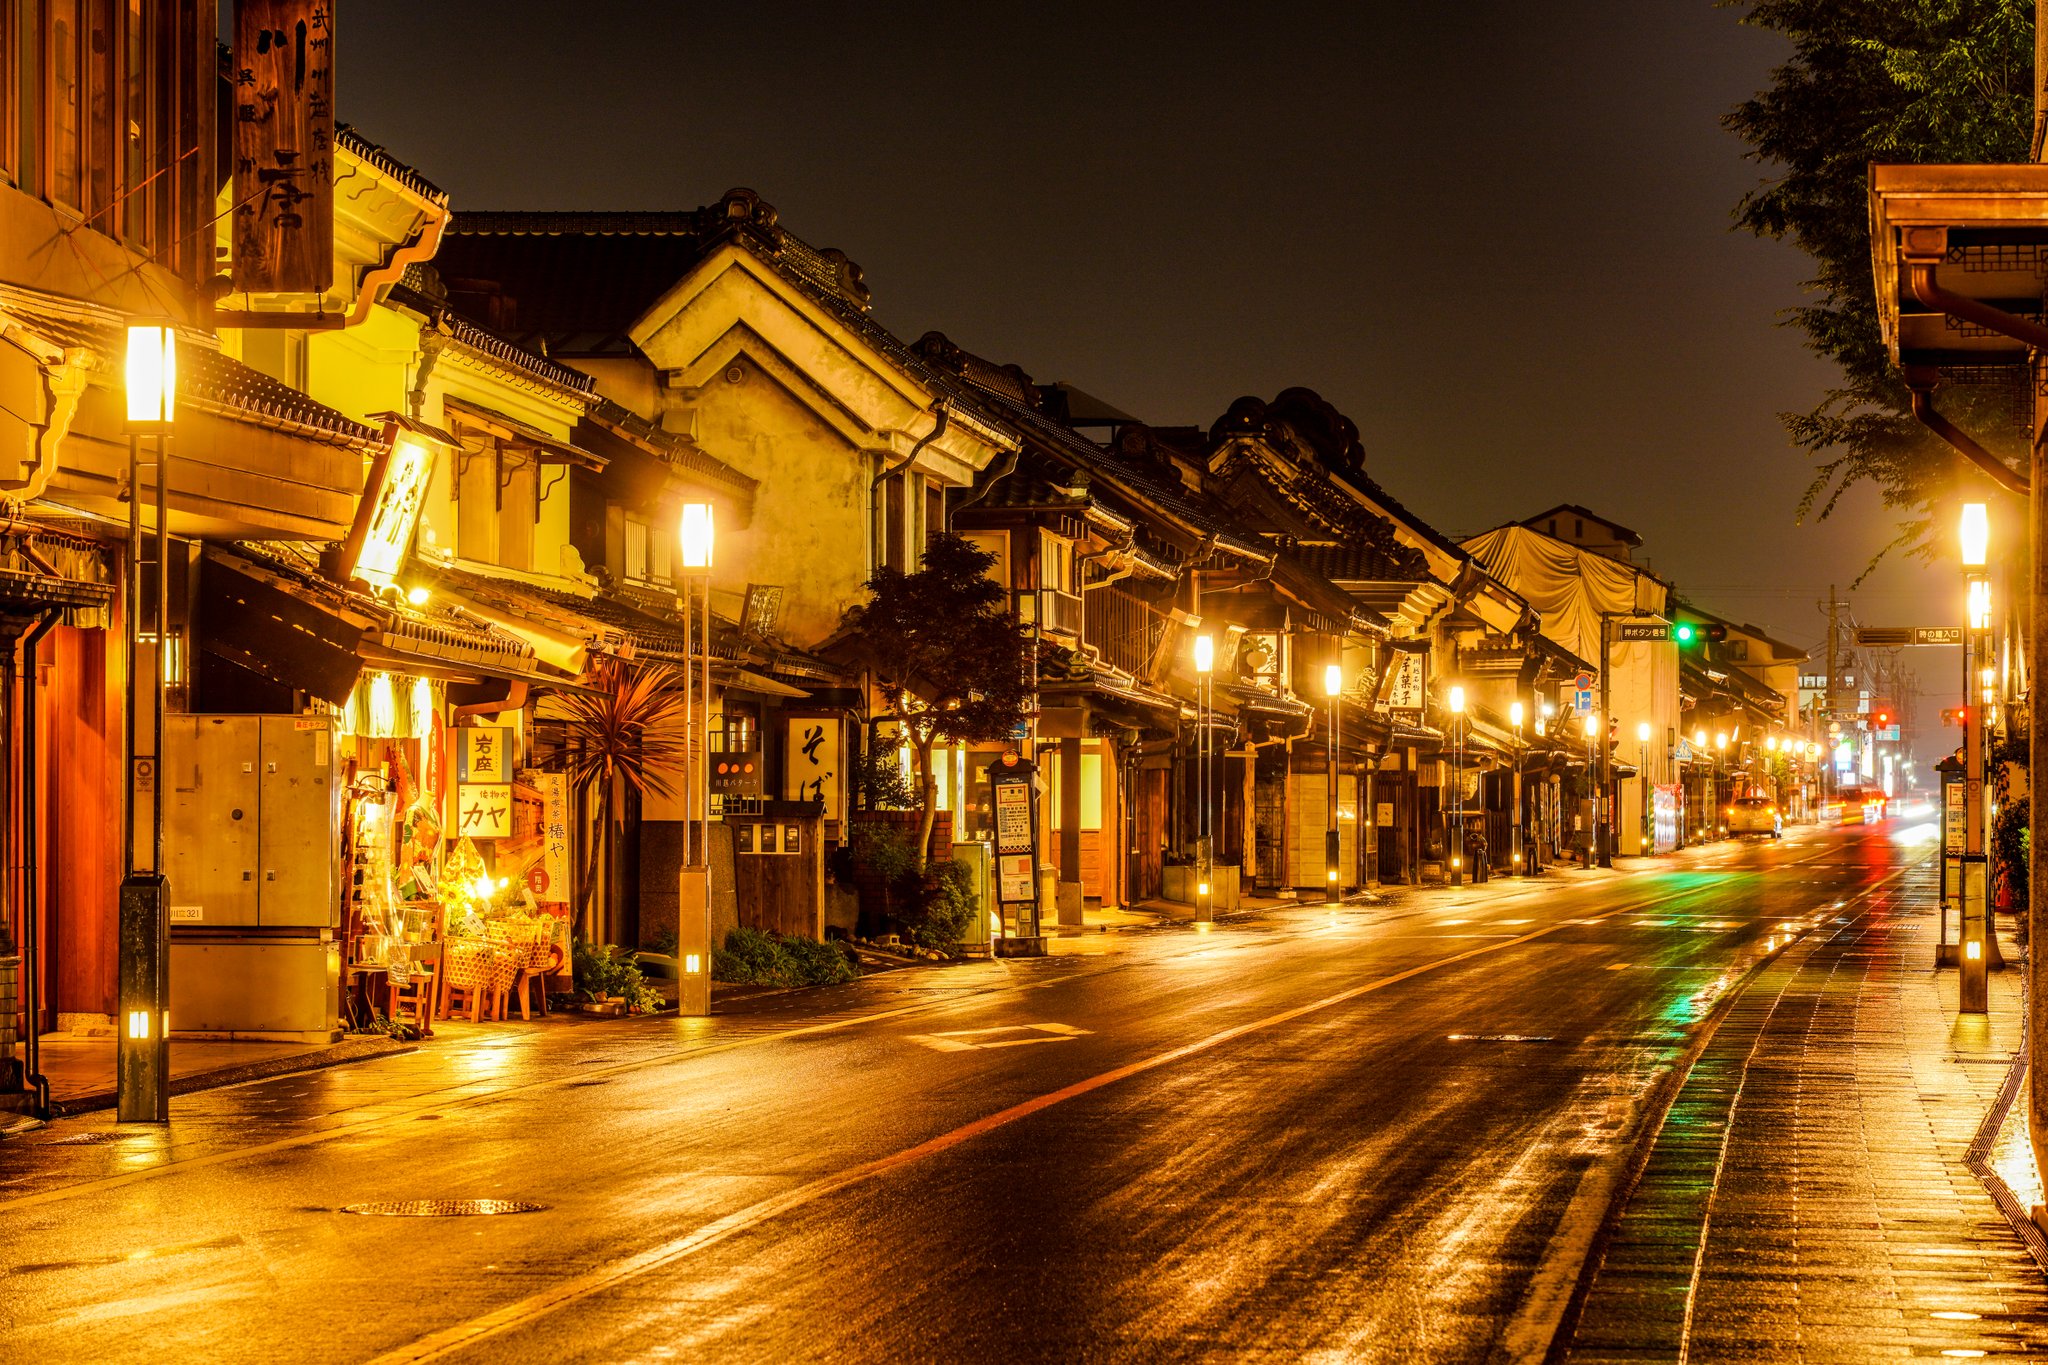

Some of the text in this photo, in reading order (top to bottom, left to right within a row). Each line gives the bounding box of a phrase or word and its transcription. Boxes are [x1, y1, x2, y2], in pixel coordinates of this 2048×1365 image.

[1624, 628, 1666, 637] 押ボタン信号
[1918, 630, 1959, 638] 時の鐘入口
[473, 732, 494, 772] 岩座
[799, 725, 833, 802] そば
[463, 802, 507, 829] カヤ
[548, 823, 565, 859] 椿や
